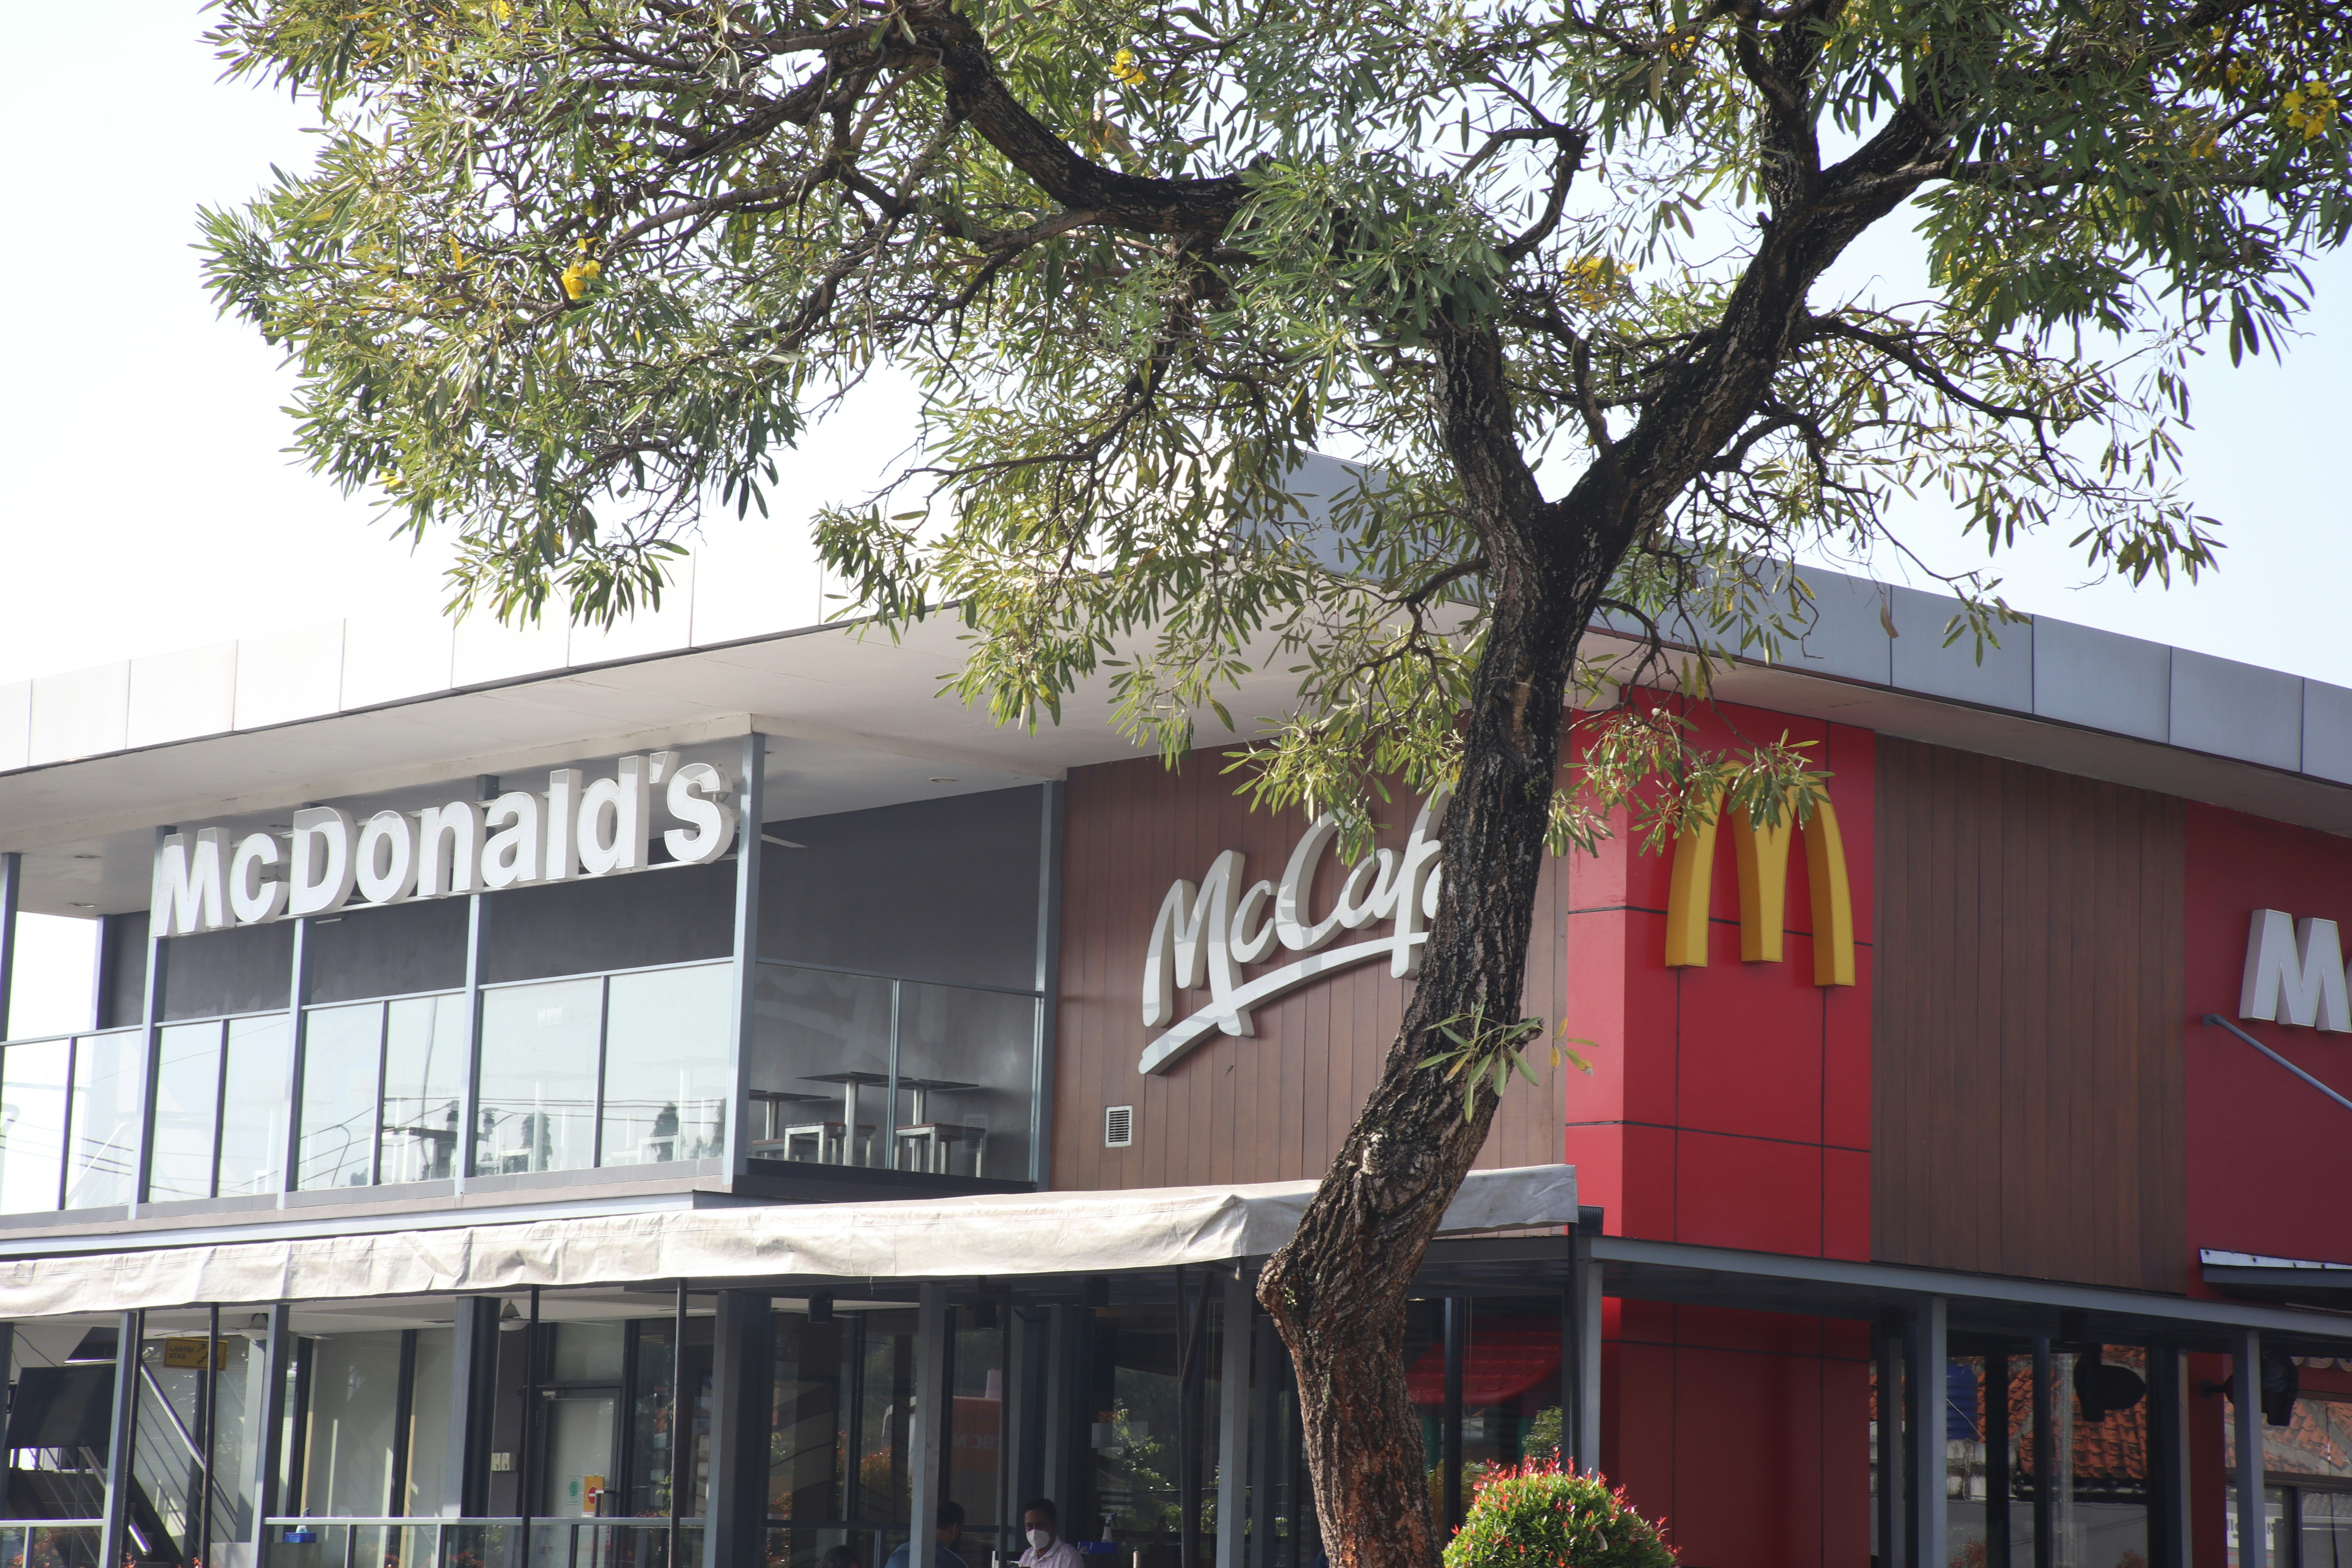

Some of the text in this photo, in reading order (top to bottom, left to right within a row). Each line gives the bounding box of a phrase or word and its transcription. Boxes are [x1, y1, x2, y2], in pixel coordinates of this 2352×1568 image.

[150, 750, 734, 938] McDonald's
[1141, 780, 1455, 1054] McCaf
[2239, 909, 2352, 1033] M
